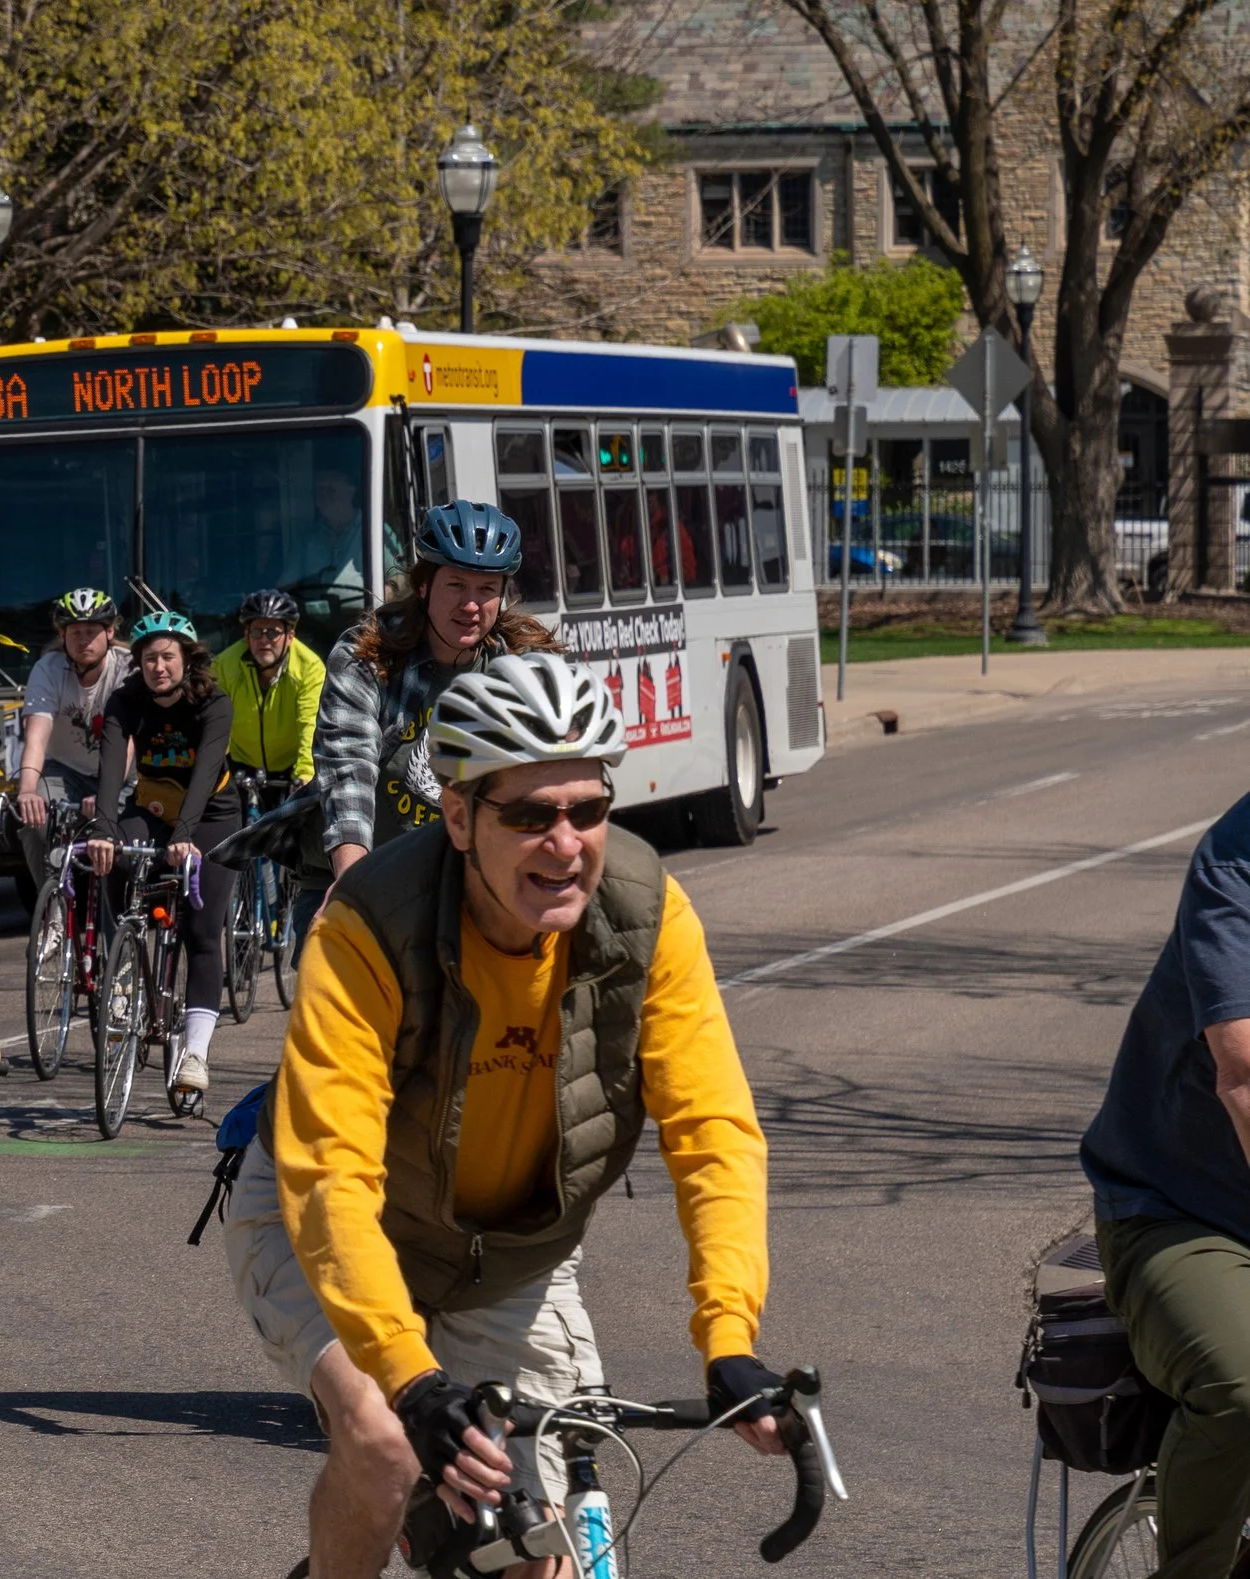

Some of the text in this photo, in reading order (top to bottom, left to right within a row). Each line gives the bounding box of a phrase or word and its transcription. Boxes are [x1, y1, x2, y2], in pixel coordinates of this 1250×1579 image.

[73, 366, 172, 412] NORTH
[182, 361, 262, 406] LOOP
[436, 361, 498, 398] metrotransit.org
[562, 611, 686, 653] Get YOUR Big Red Check Today!
[468, 1055, 516, 1077] BANK
